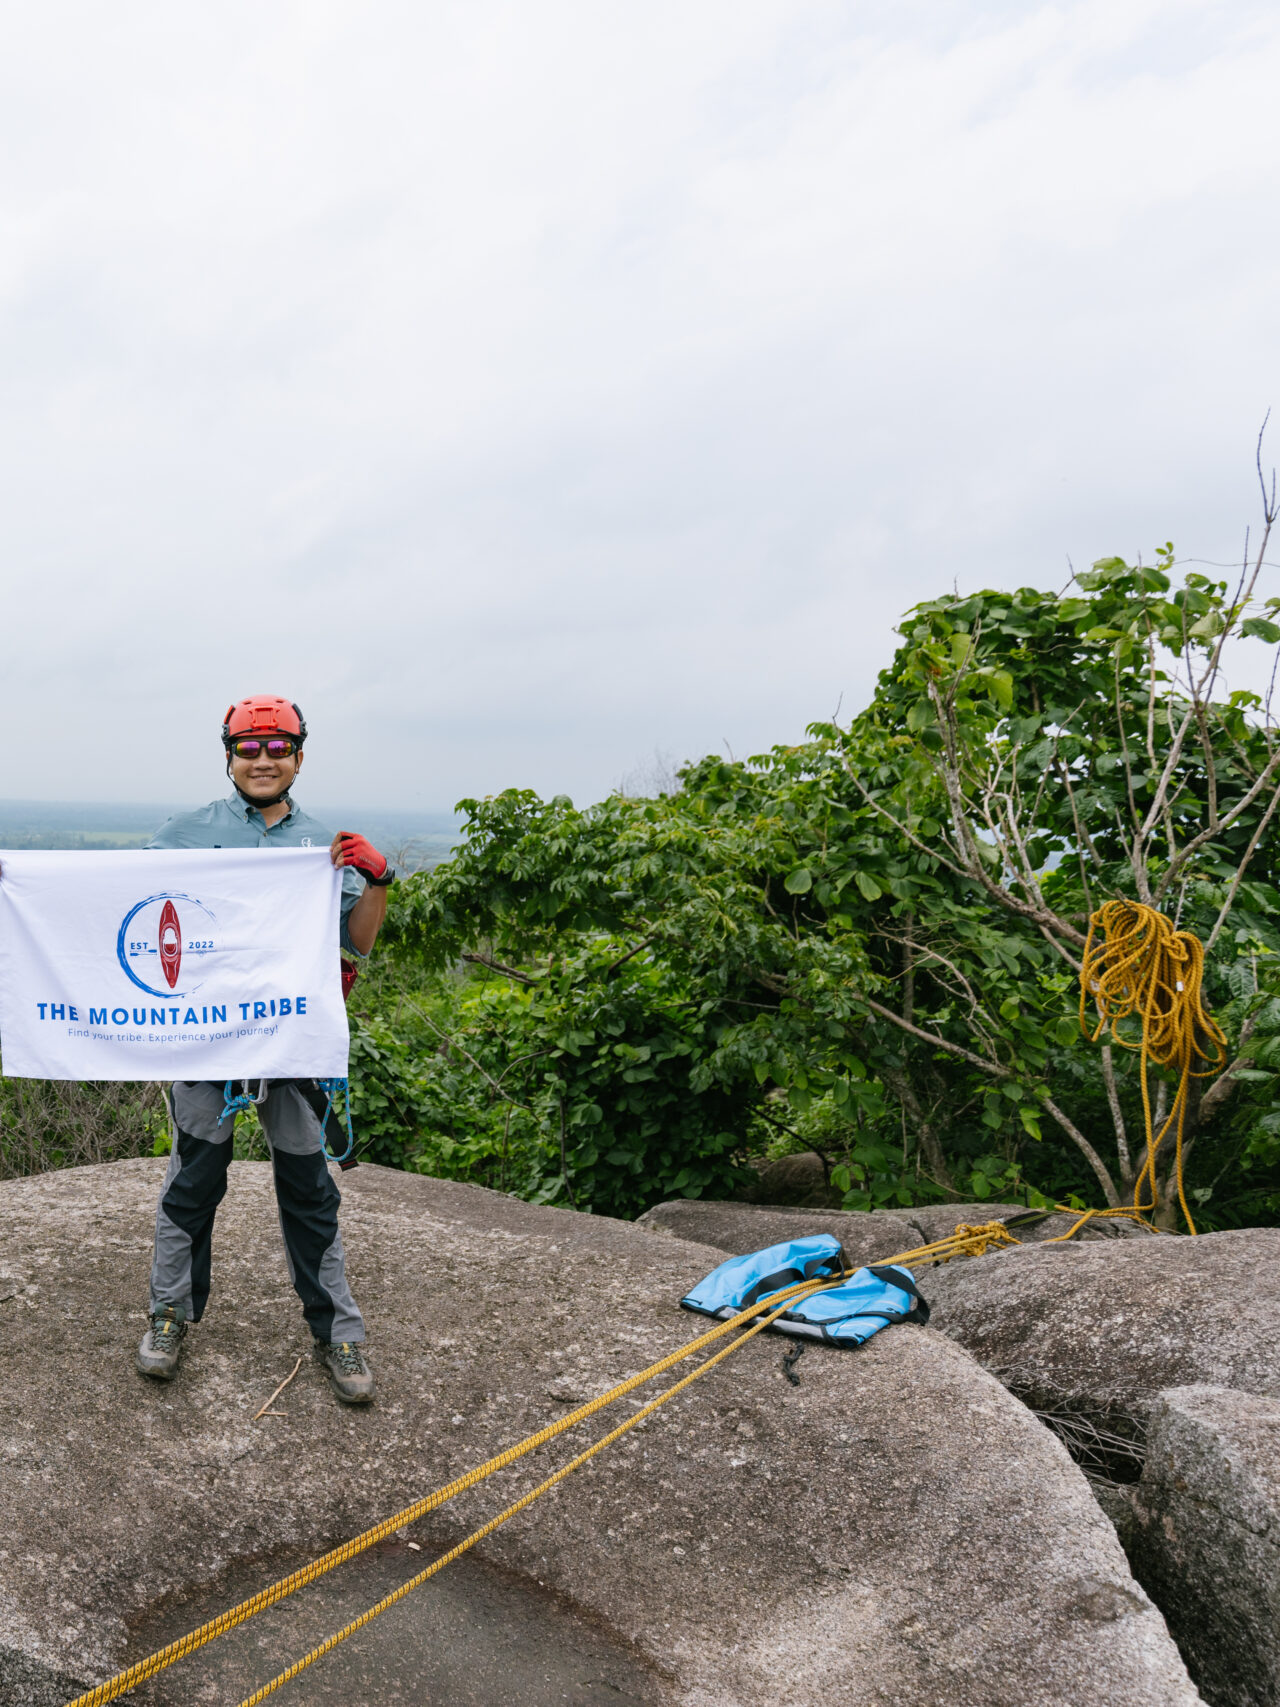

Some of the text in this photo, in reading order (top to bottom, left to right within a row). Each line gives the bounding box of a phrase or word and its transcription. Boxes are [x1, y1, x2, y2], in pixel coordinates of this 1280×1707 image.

[130, 940, 215, 950] EST 2022
[36, 996, 307, 1026] THE MOUNTAIN TRIBE
[68, 1024, 279, 1044] Find your tribe. Experience your journey!
